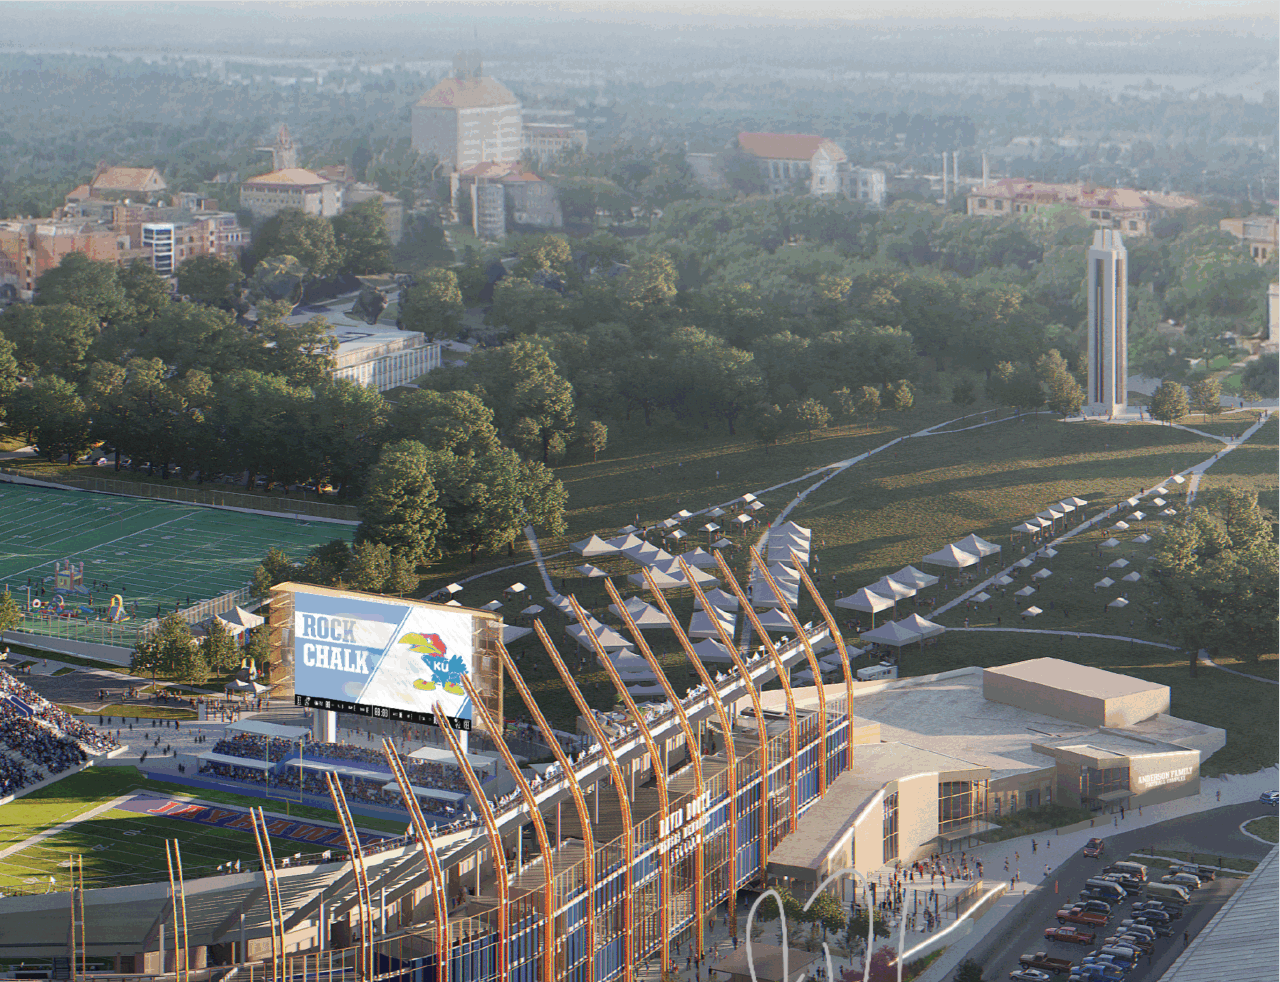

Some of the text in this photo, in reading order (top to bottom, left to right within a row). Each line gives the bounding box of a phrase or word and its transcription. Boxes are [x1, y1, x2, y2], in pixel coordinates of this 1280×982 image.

[302, 614, 357, 644] ROCK
[303, 643, 370, 675] CHALK
[433, 661, 450, 673] KU
